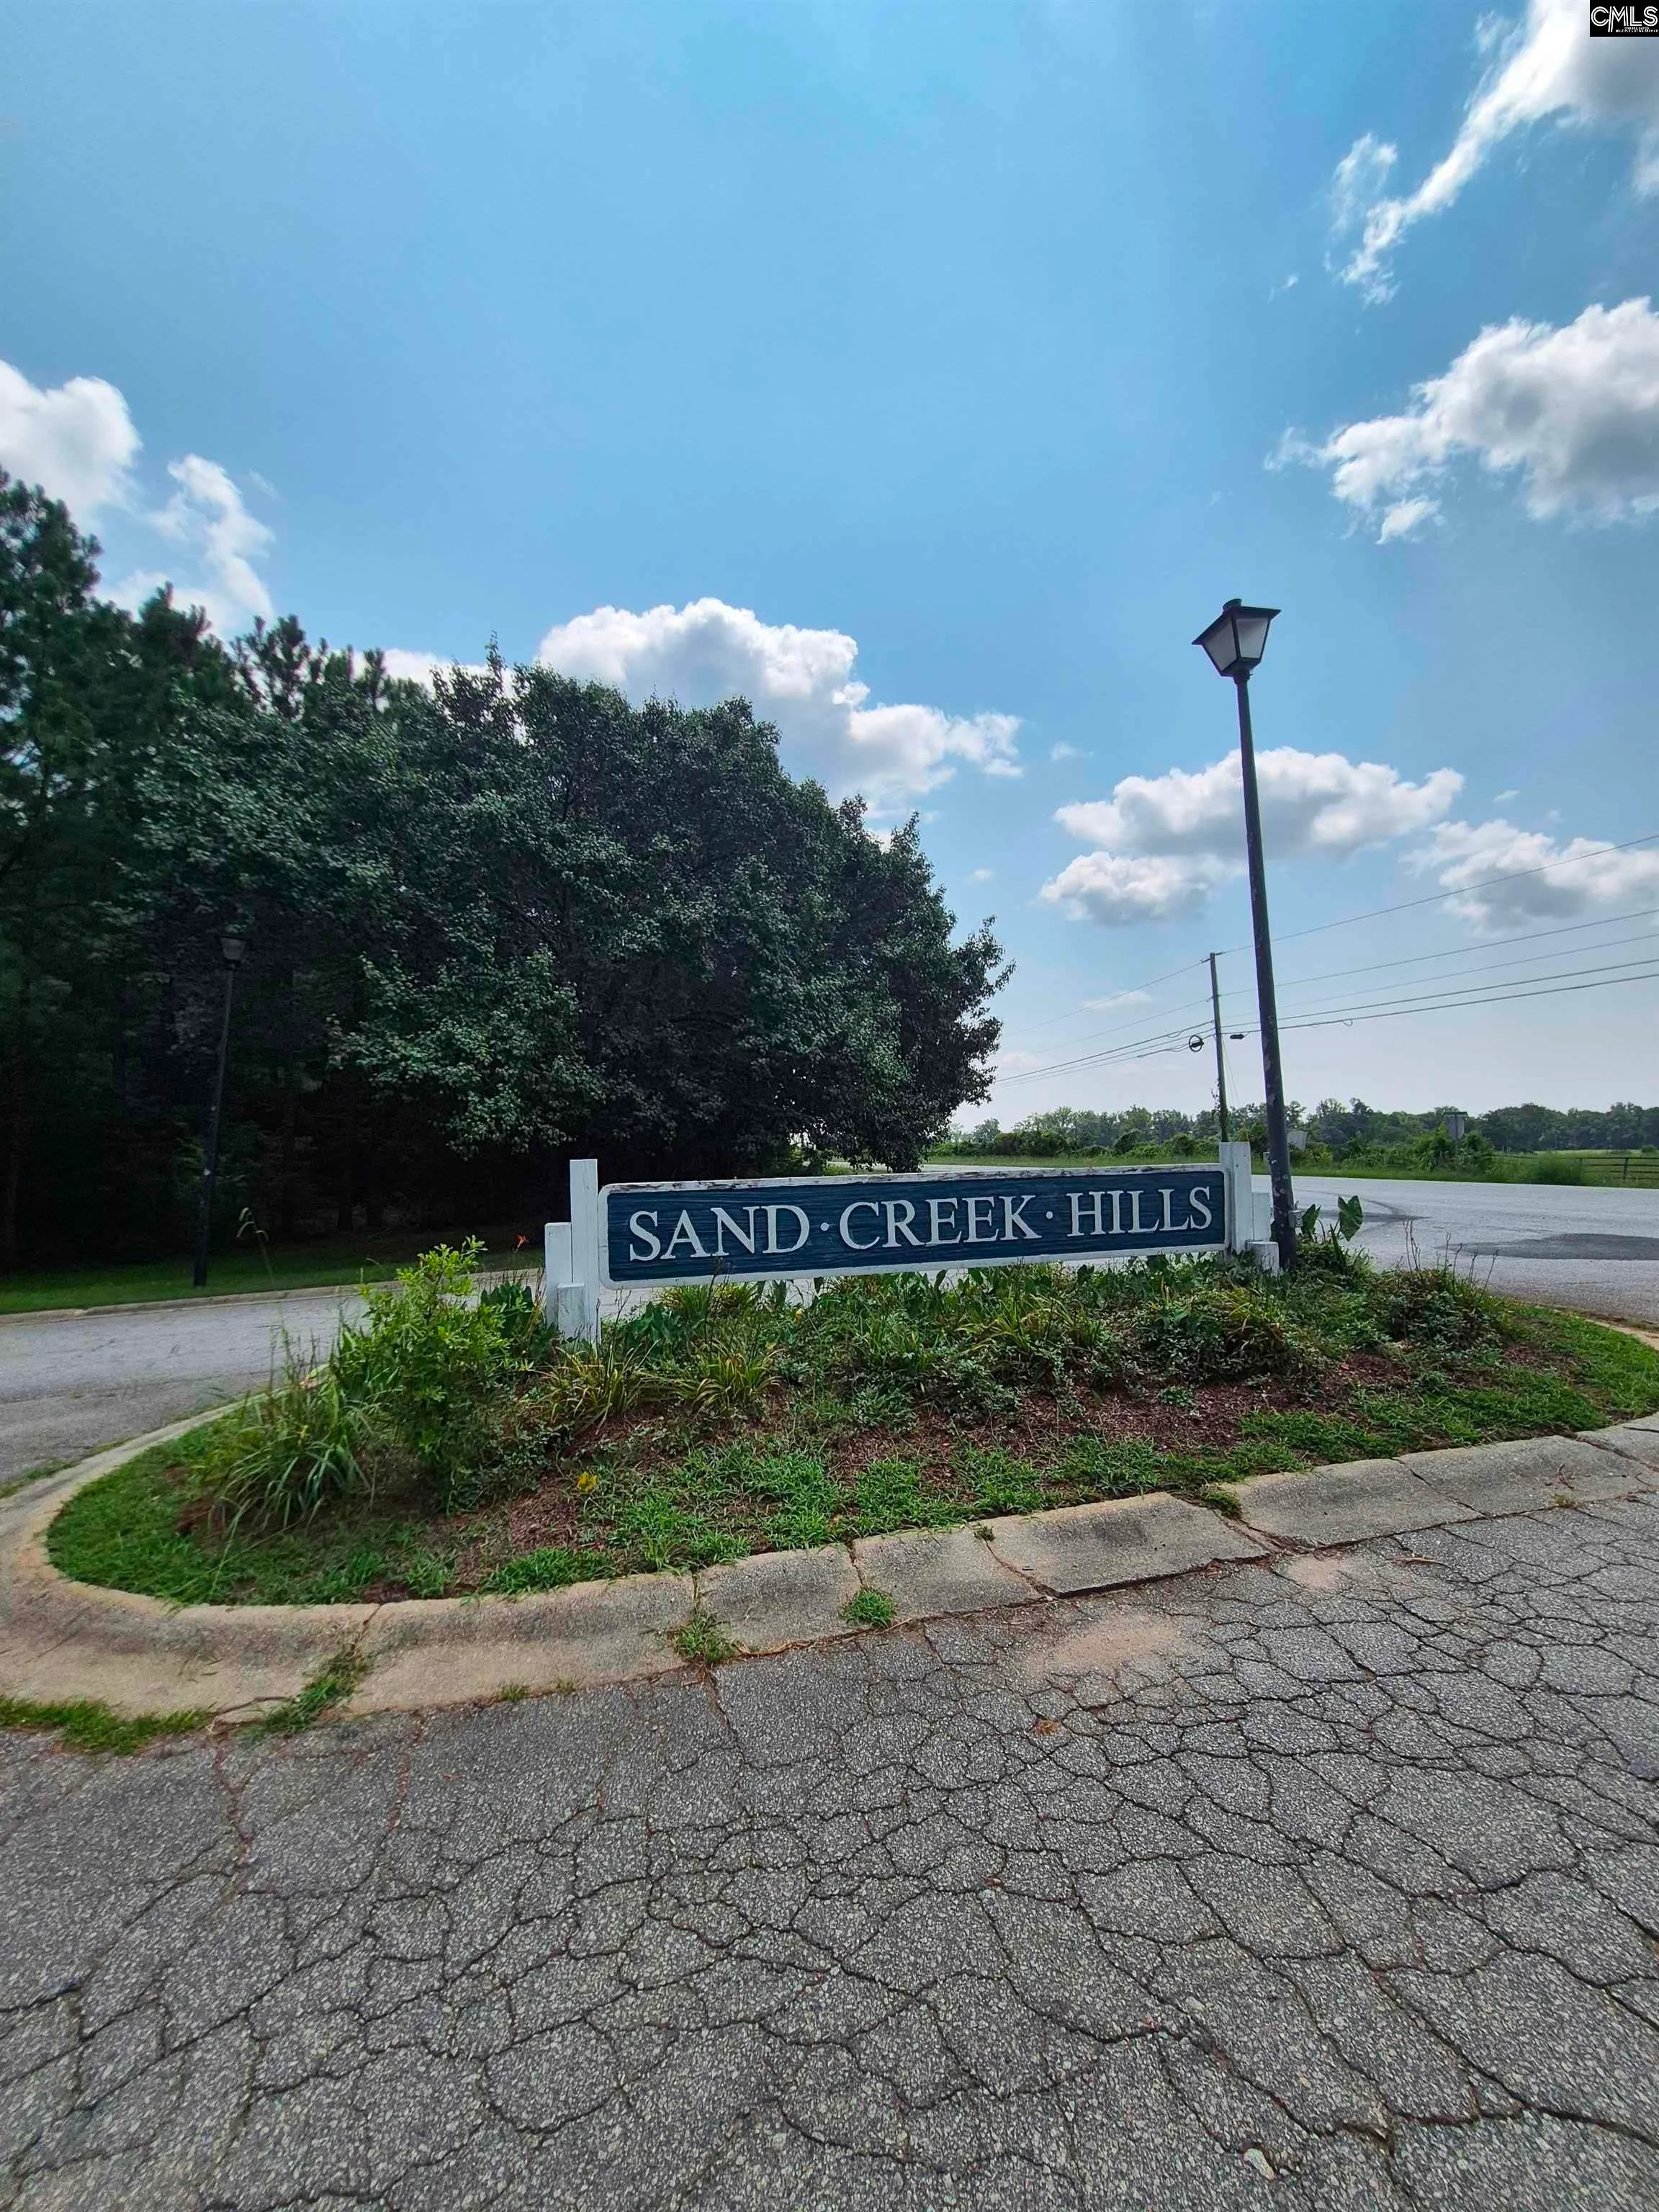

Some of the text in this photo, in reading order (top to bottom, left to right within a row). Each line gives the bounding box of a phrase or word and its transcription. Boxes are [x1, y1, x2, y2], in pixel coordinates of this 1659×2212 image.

[629, 1186, 1213, 1262] SAND CREEK HILLS
